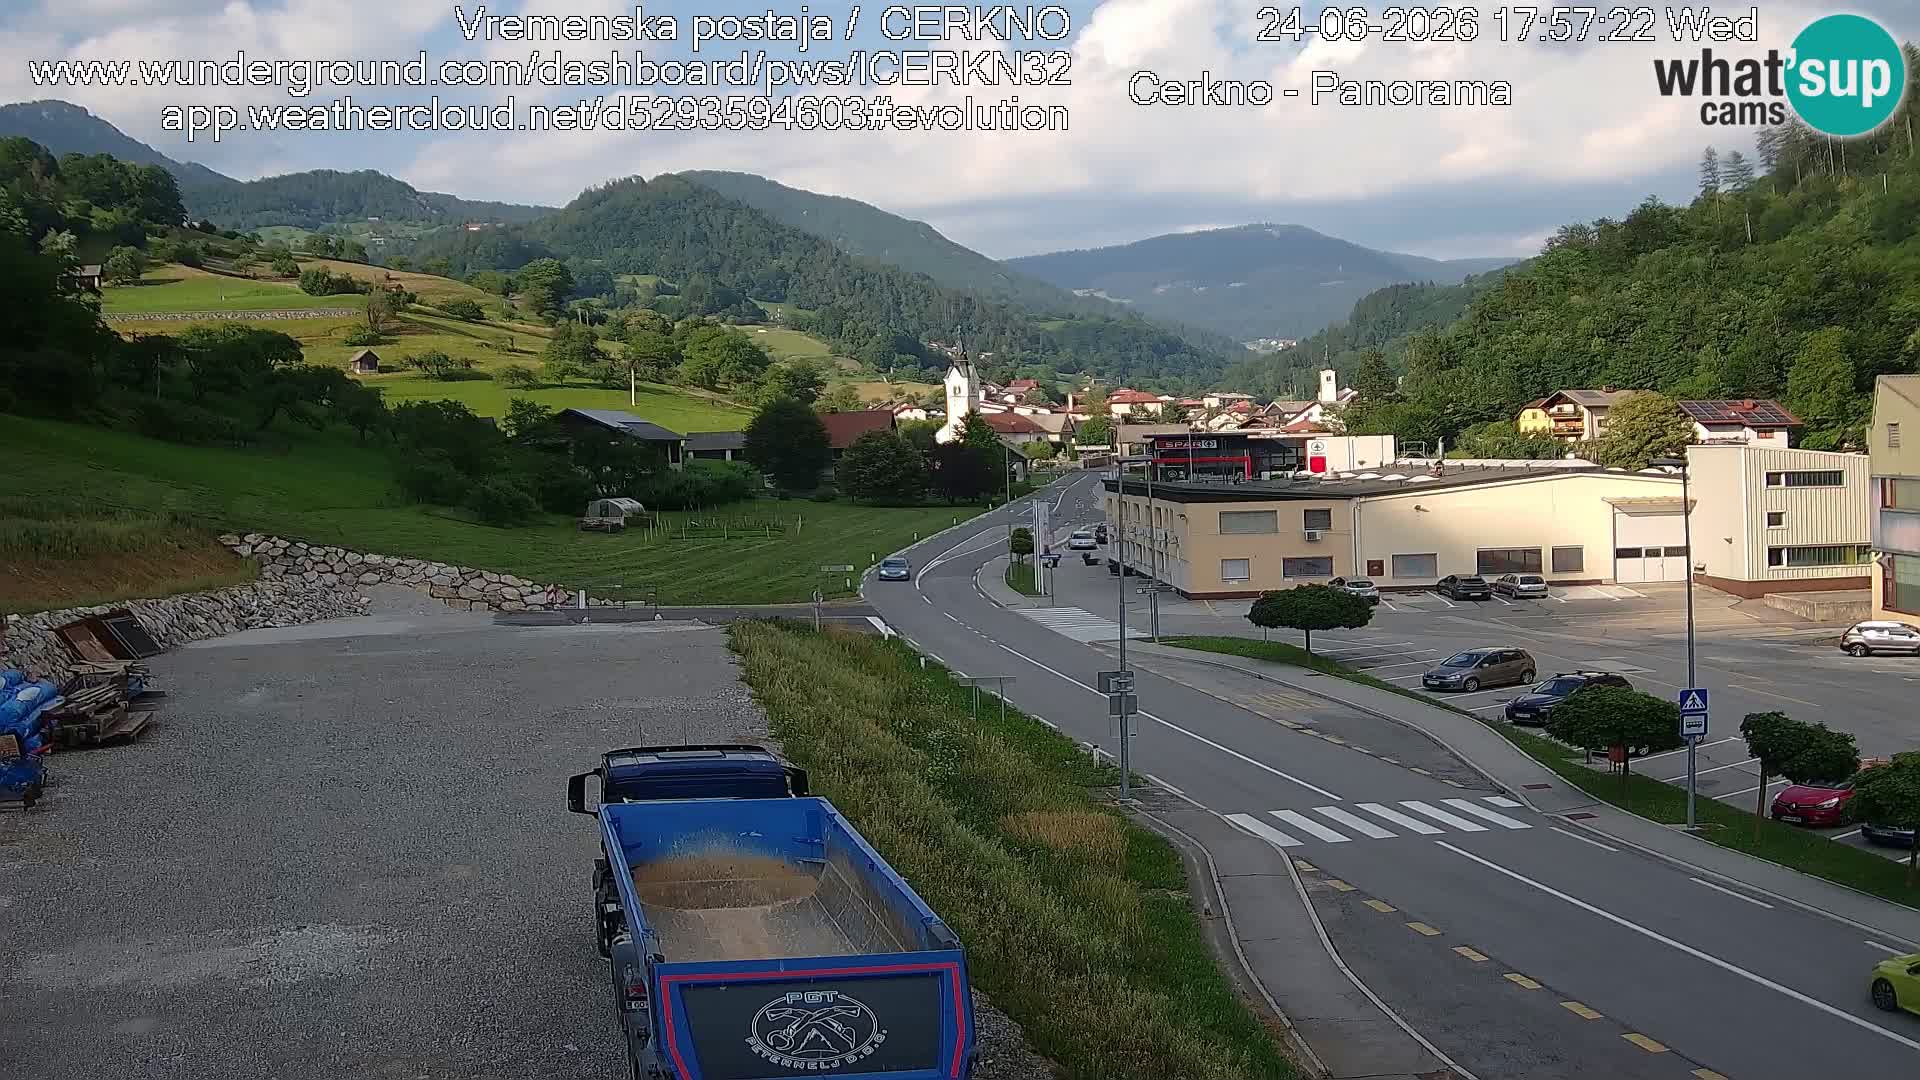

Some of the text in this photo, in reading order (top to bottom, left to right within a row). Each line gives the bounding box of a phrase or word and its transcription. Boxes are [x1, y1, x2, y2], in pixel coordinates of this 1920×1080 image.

[1166, 441, 1201, 449] SPAR
[786, 990, 838, 1004] PGT
[745, 1036, 841, 1070] PETERNELJ
